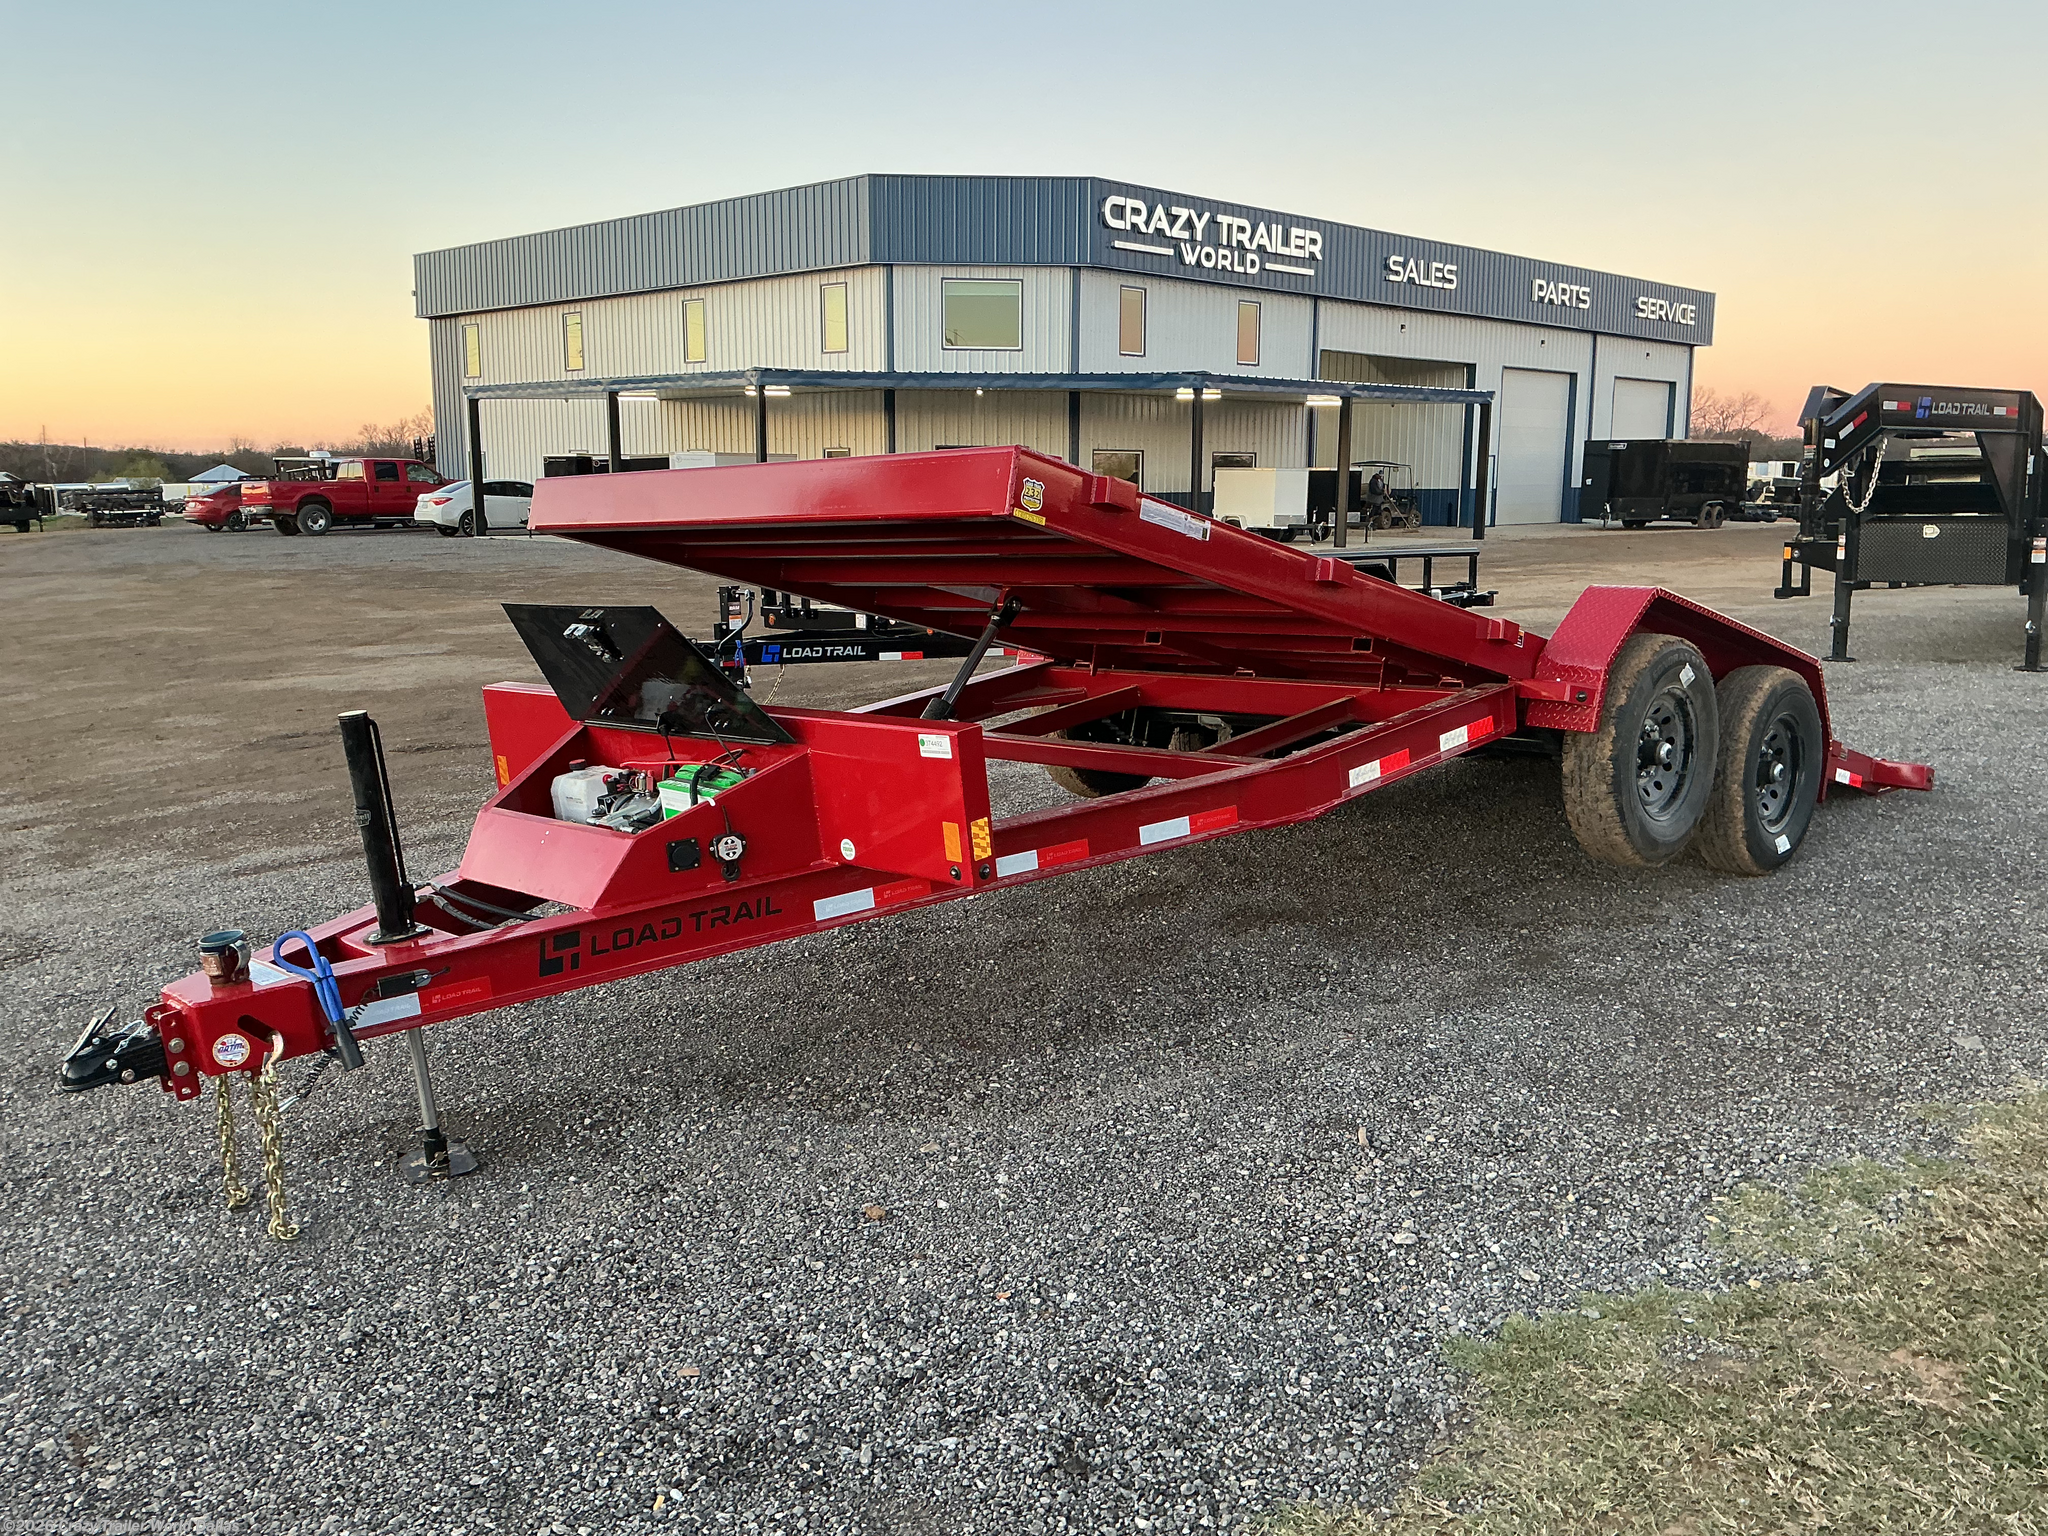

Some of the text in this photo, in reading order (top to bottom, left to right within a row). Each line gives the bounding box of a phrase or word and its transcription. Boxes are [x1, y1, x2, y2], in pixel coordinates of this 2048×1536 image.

[1103, 195, 1323, 260] CRAZY TRAILER
[1180, 242, 1260, 274] WORLD
[1387, 255, 1457, 290] SALES
[1533, 278, 1590, 310] PARTS
[1635, 296, 1696, 326] SERVICE
[1931, 402, 1961, 415] LOAD
[1961, 403, 1990, 415] TRAIL
[1026, 487, 1040, 498] 232
[782, 647, 822, 658] LOAD
[824, 646, 866, 656] TRAIL
[591, 916, 682, 956] LOAD
[689, 896, 783, 932] TRAIL
[441, 991, 461, 1000] LOAD
[462, 986, 482, 995] TRAIL
